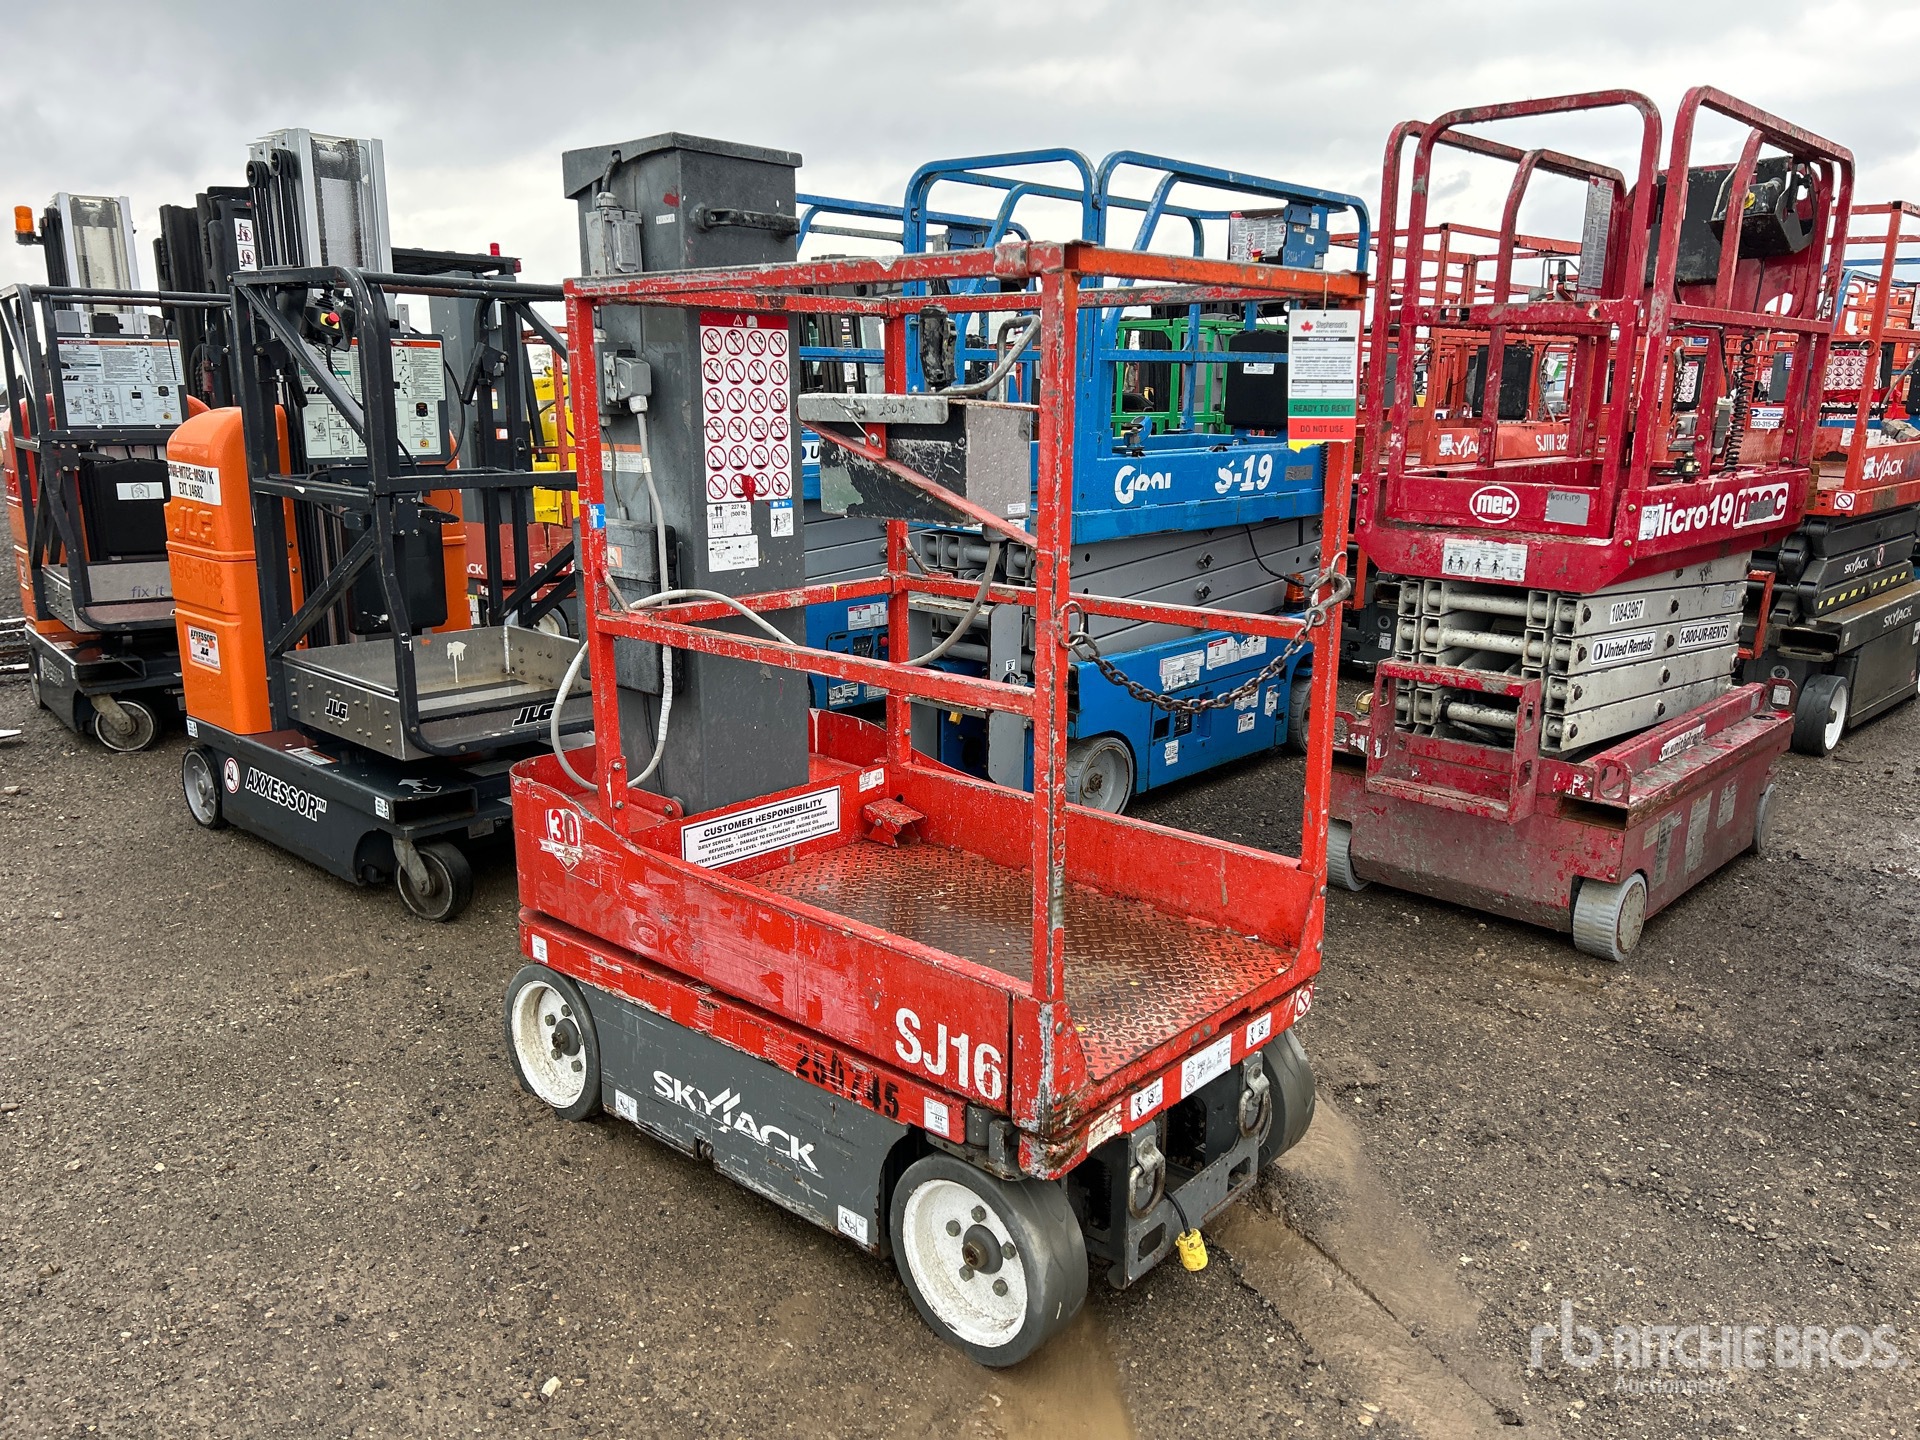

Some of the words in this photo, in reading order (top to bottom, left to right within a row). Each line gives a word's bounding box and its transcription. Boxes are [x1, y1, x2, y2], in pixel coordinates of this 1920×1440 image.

[1294, 404, 1317, 413] READY
[1319, 404, 1329, 413] TO
[1332, 404, 1352, 413] RENT
[1300, 425, 1311, 433] DO
[1313, 425, 1328, 433] NOT
[1330, 425, 1345, 433] USE
[1556, 433, 1569, 451] 32
[1214, 453, 1273, 494] S-19
[1550, 492, 1581, 503] working
[131, 585, 149, 598] fix
[1611, 599, 1644, 623] 10843967
[1603, 641, 1628, 659] United
[1628, 636, 1653, 655] Rentals
[325, 698, 348, 720] JLG
[512, 703, 554, 728] JLG
[550, 809, 579, 846] 30
[704, 817, 753, 837] CUSTOMER
[755, 798, 823, 823] RESPONSIBILITY
[691, 857, 711, 865] ATTERY
[711, 848, 743, 860] ELECTROLYTE
[743, 843, 757, 851] LEVEL
[760, 839, 773, 847] PAINT
[774, 834, 791, 843] STUCCO
[698, 843, 711, 851] DAILY
[712, 837, 732, 847] SERVICE
[737, 827, 767, 839] LUBRICATION
[708, 844, 734, 854] REFUELING
[739, 836, 758, 846] DAMAGE
[766, 827, 791, 838] EQUIPMENT
[895, 1007, 1003, 1101] SJ16
[652, 1069, 820, 1173] SKYJACK
